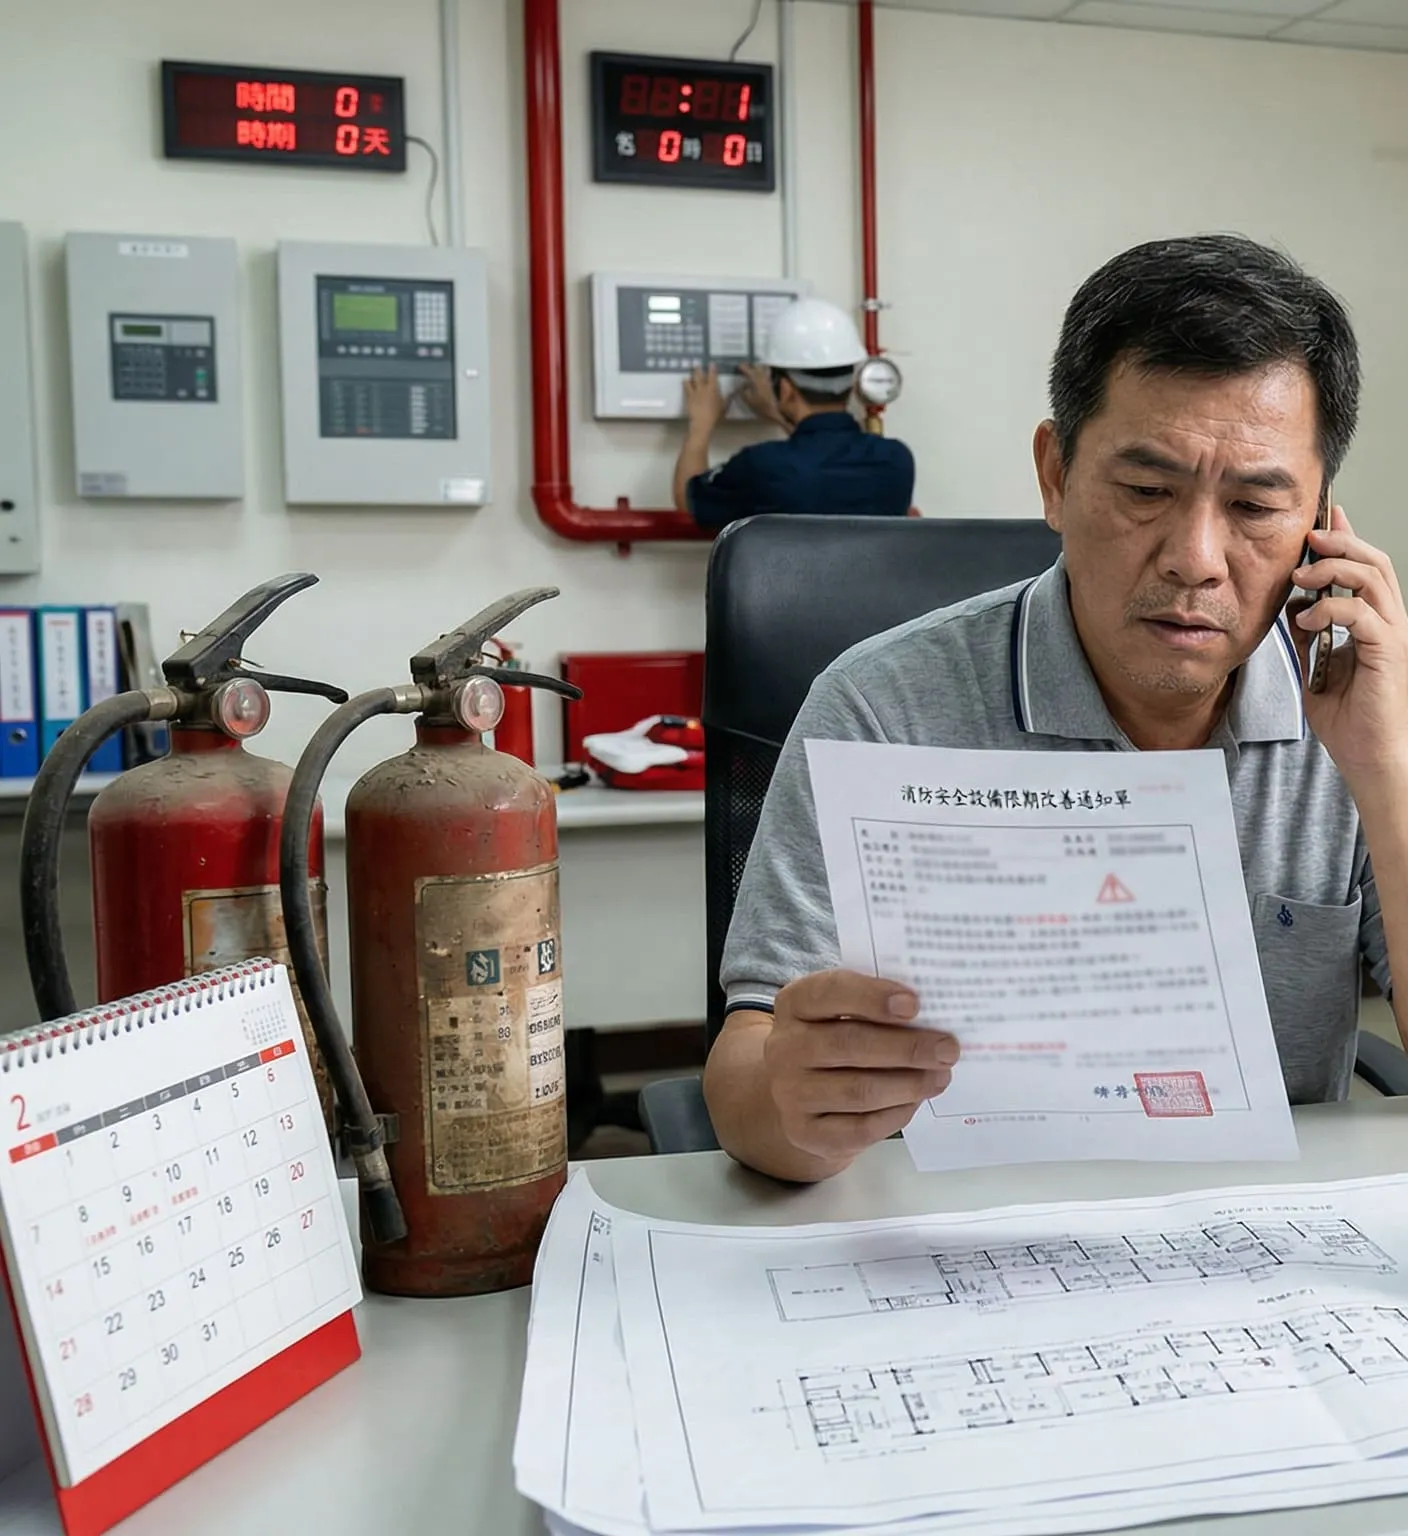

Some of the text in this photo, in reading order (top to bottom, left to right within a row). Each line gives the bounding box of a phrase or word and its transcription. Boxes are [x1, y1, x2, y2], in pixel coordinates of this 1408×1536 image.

[235, 81, 359, 118] 時間 0
[236, 120, 296, 150] 時期
[900, 784, 1131, 810] 消防安全設備限期改善通知單
[11, 1094, 31, 1131] 2
[66, 1069, 275, 1166] 1 2 3 4 5 6
[30, 1114, 294, 1244] 7 8 9 10 11 12 13
[46, 1161, 305, 1300] 14 15 16 17 18 19 20
[59, 1210, 314, 1361] 21 22 23 24 25 26 27
[74, 1321, 218, 1417] 28 29 30 31
